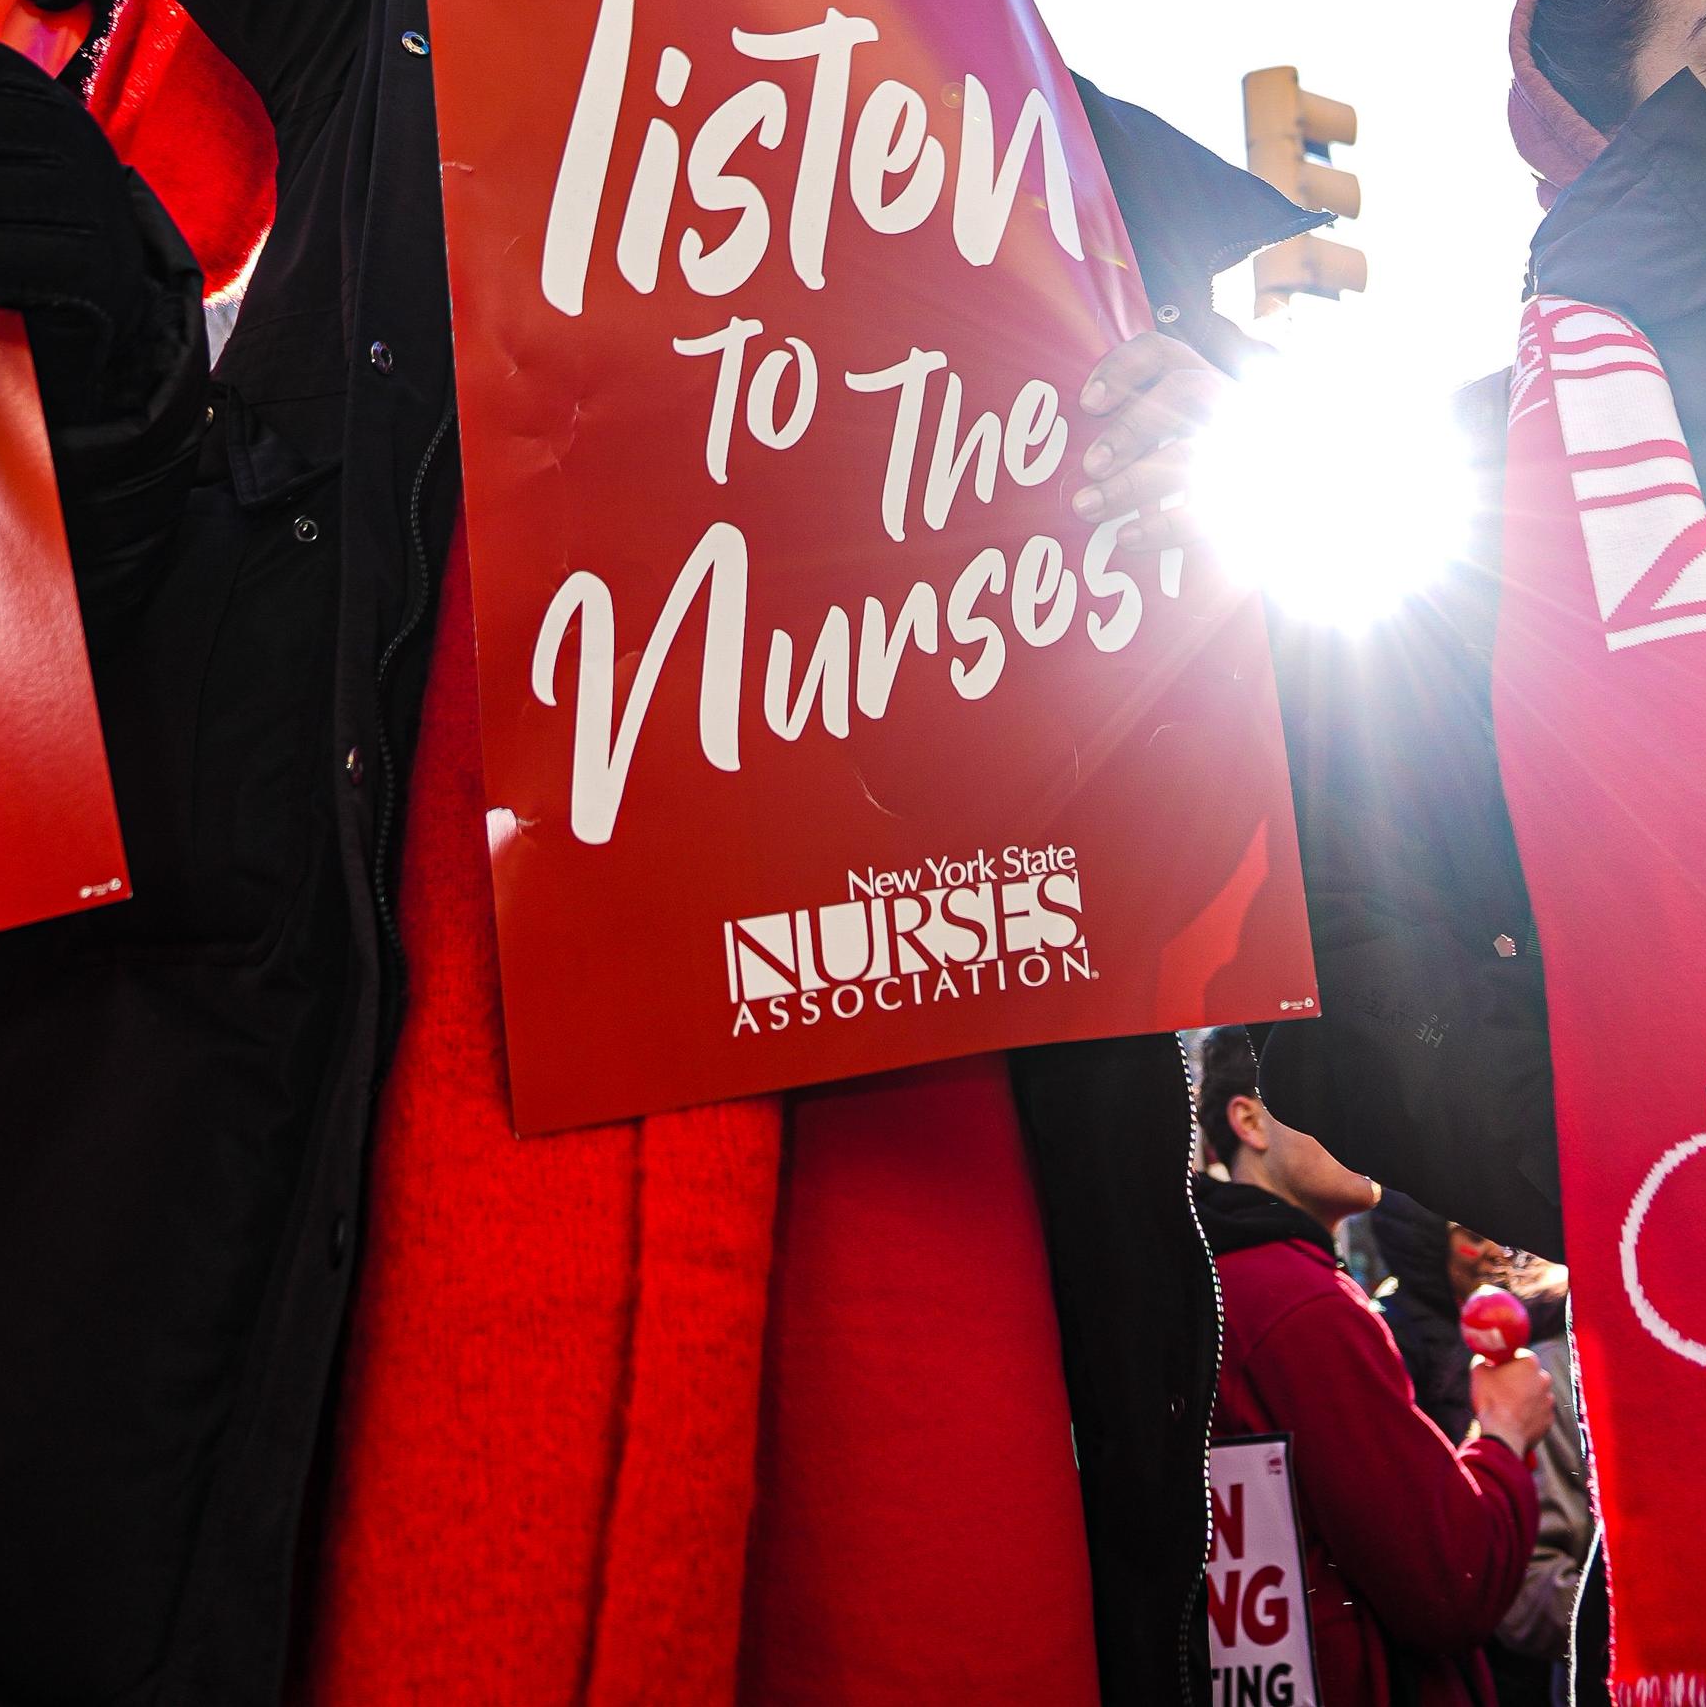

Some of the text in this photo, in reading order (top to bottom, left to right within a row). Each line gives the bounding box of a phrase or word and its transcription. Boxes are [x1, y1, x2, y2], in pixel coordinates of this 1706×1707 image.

[847, 843, 1077, 901] New York State
[723, 870, 1083, 1004] NURSES
[731, 948, 1092, 1038] ASSOCIATION
